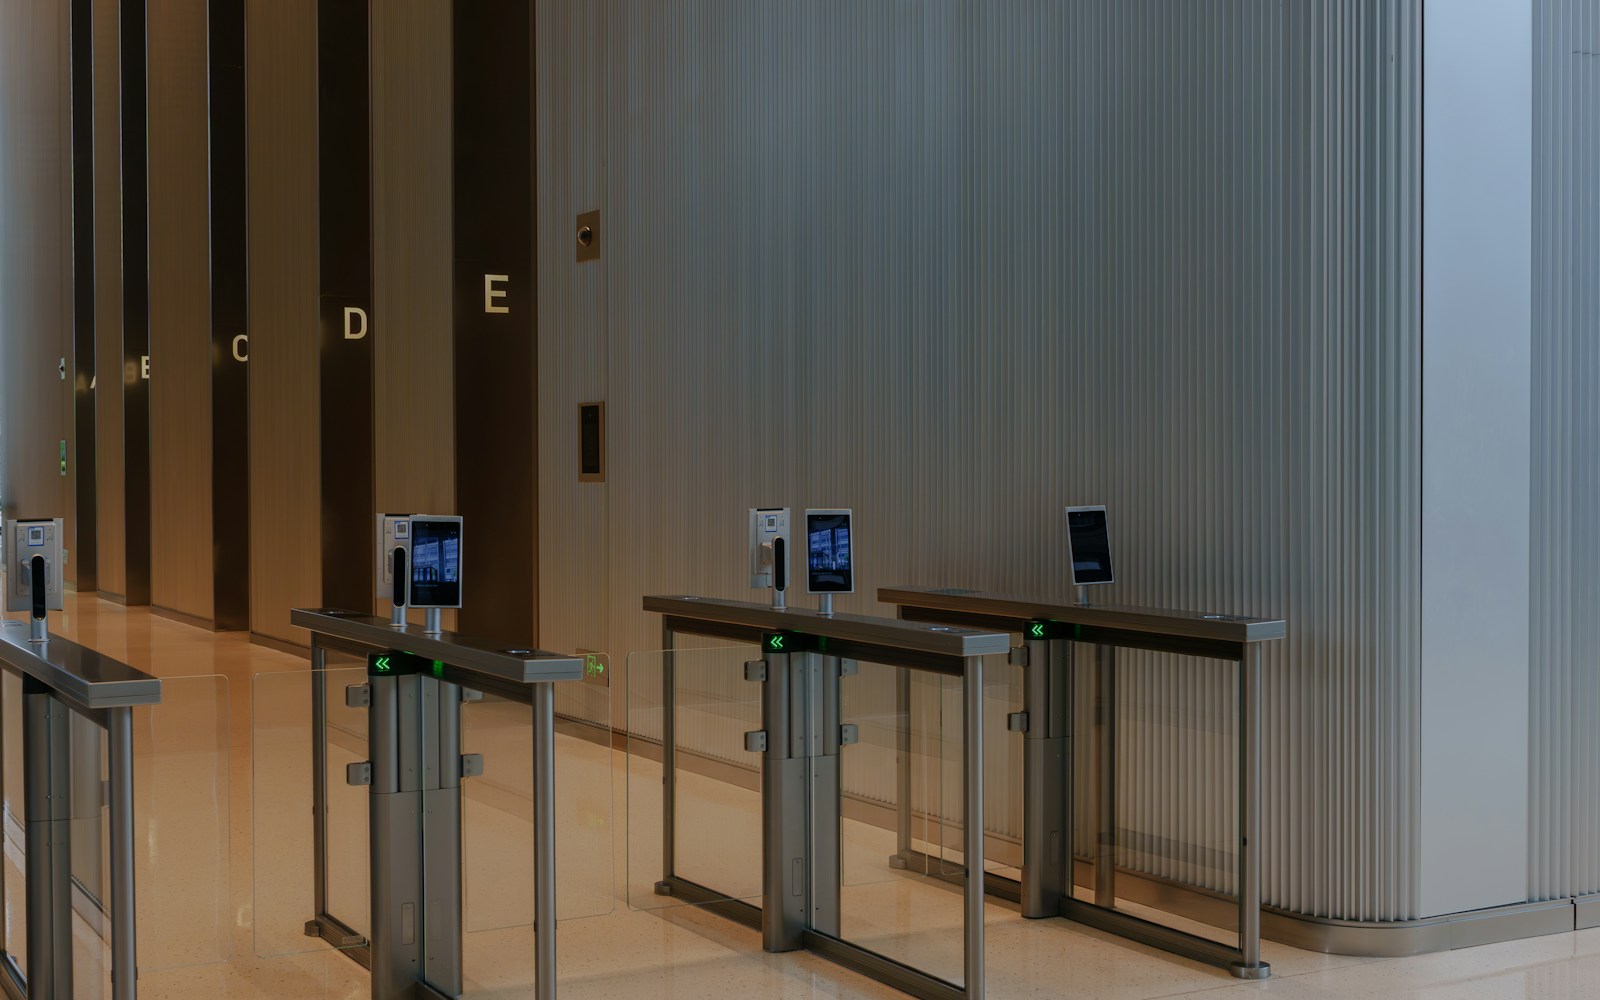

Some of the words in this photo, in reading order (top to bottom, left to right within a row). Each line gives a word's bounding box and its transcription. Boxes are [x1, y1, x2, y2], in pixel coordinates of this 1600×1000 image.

[484, 274, 509, 314] E
[344, 306, 368, 340] D
[232, 334, 248, 362] C
